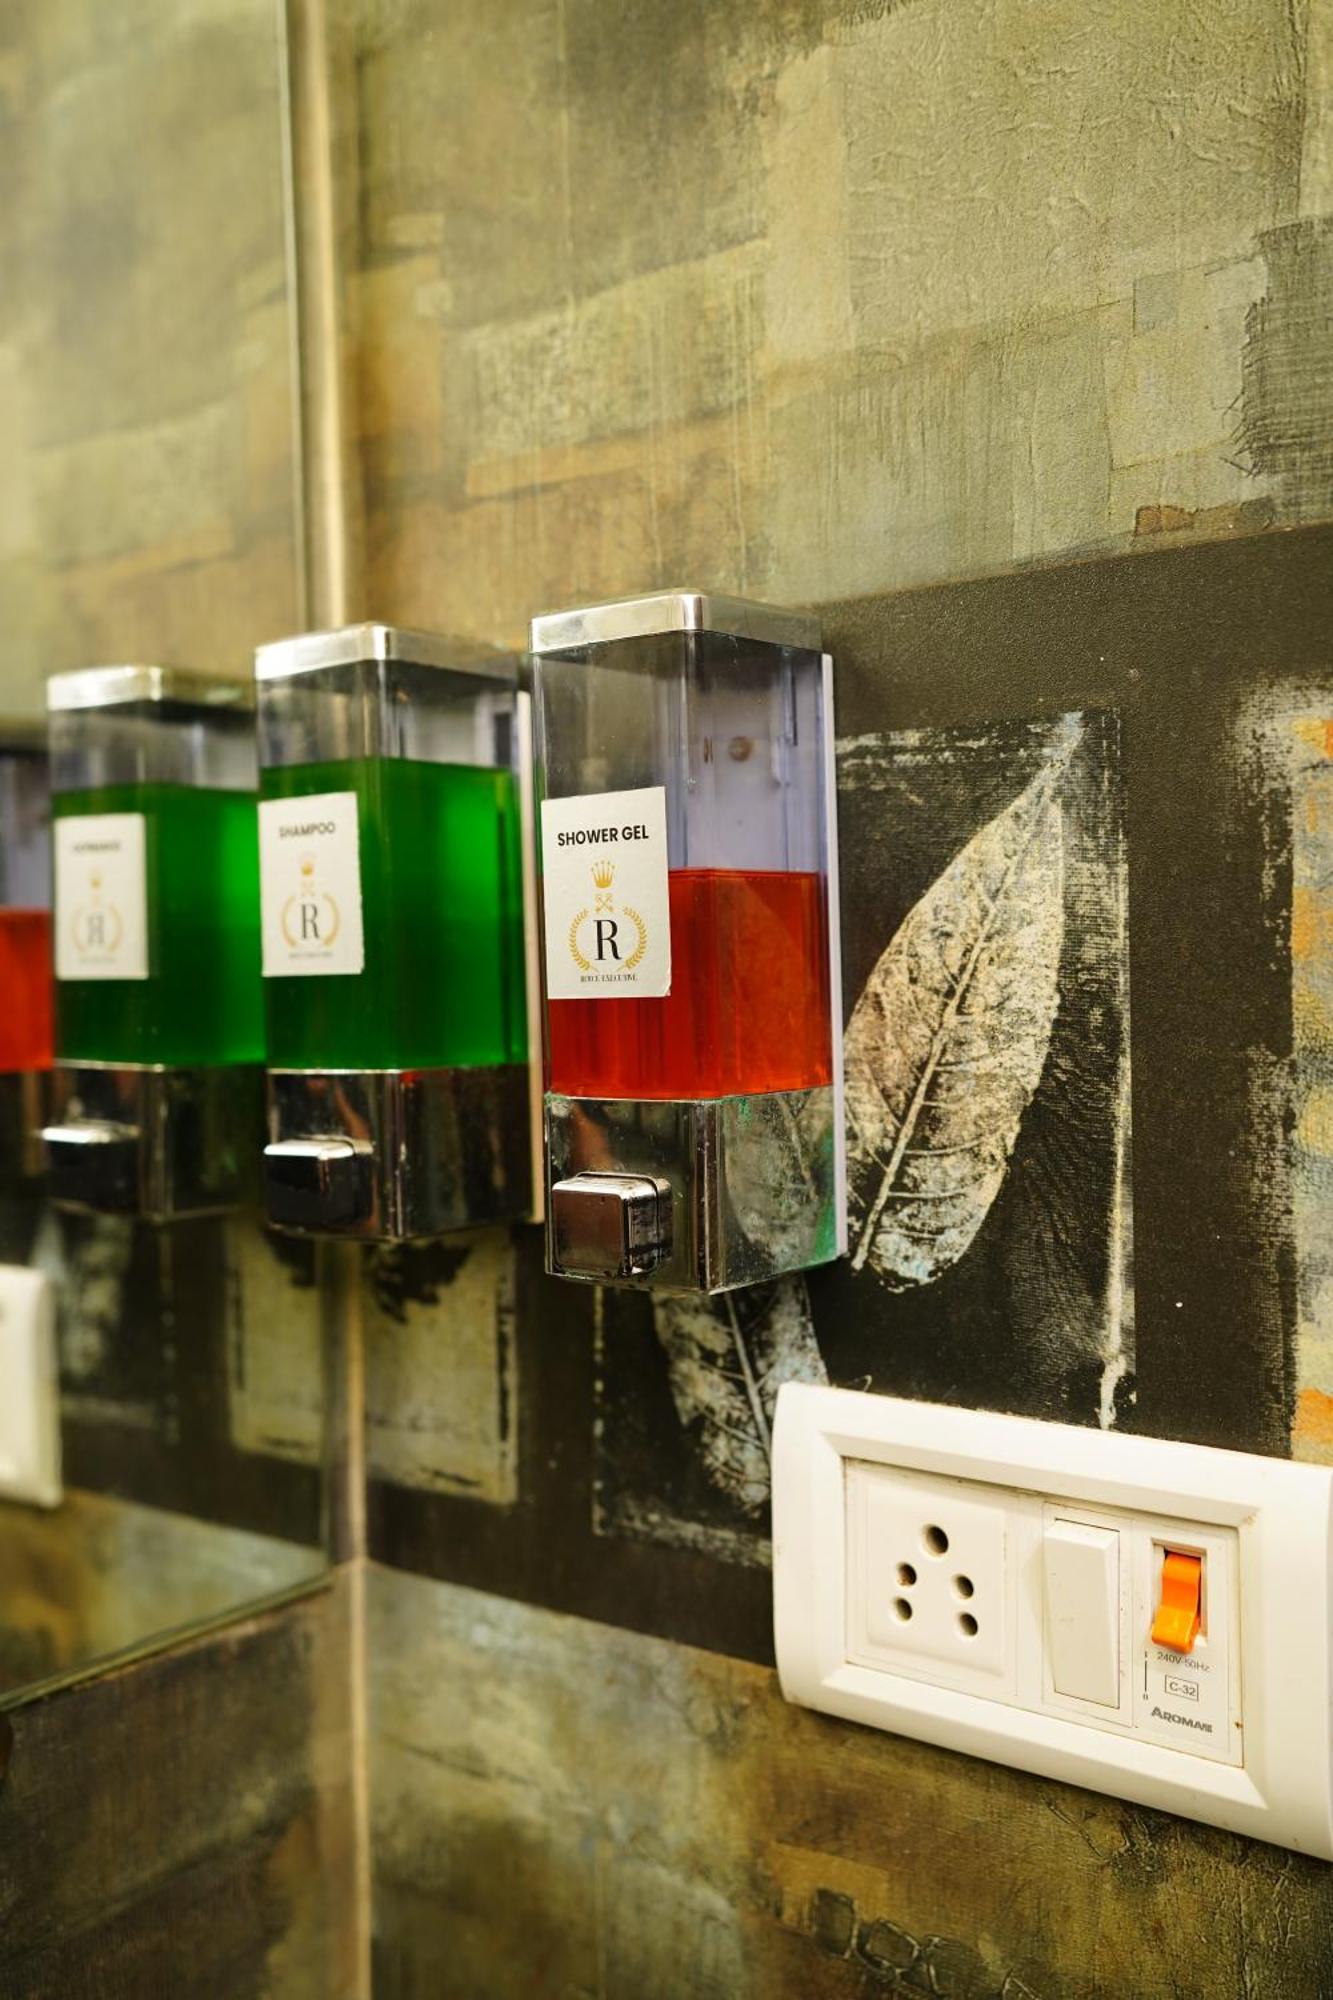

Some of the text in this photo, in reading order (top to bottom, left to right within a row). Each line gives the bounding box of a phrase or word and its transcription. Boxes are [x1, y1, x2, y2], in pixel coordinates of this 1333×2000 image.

[279, 821, 336, 839] SHAMPOO
[557, 824, 649, 846] SHOWER GEL
[301, 903, 320, 939] R
[593, 919, 622, 961] R
[1169, 1681, 1196, 1697] C-32
